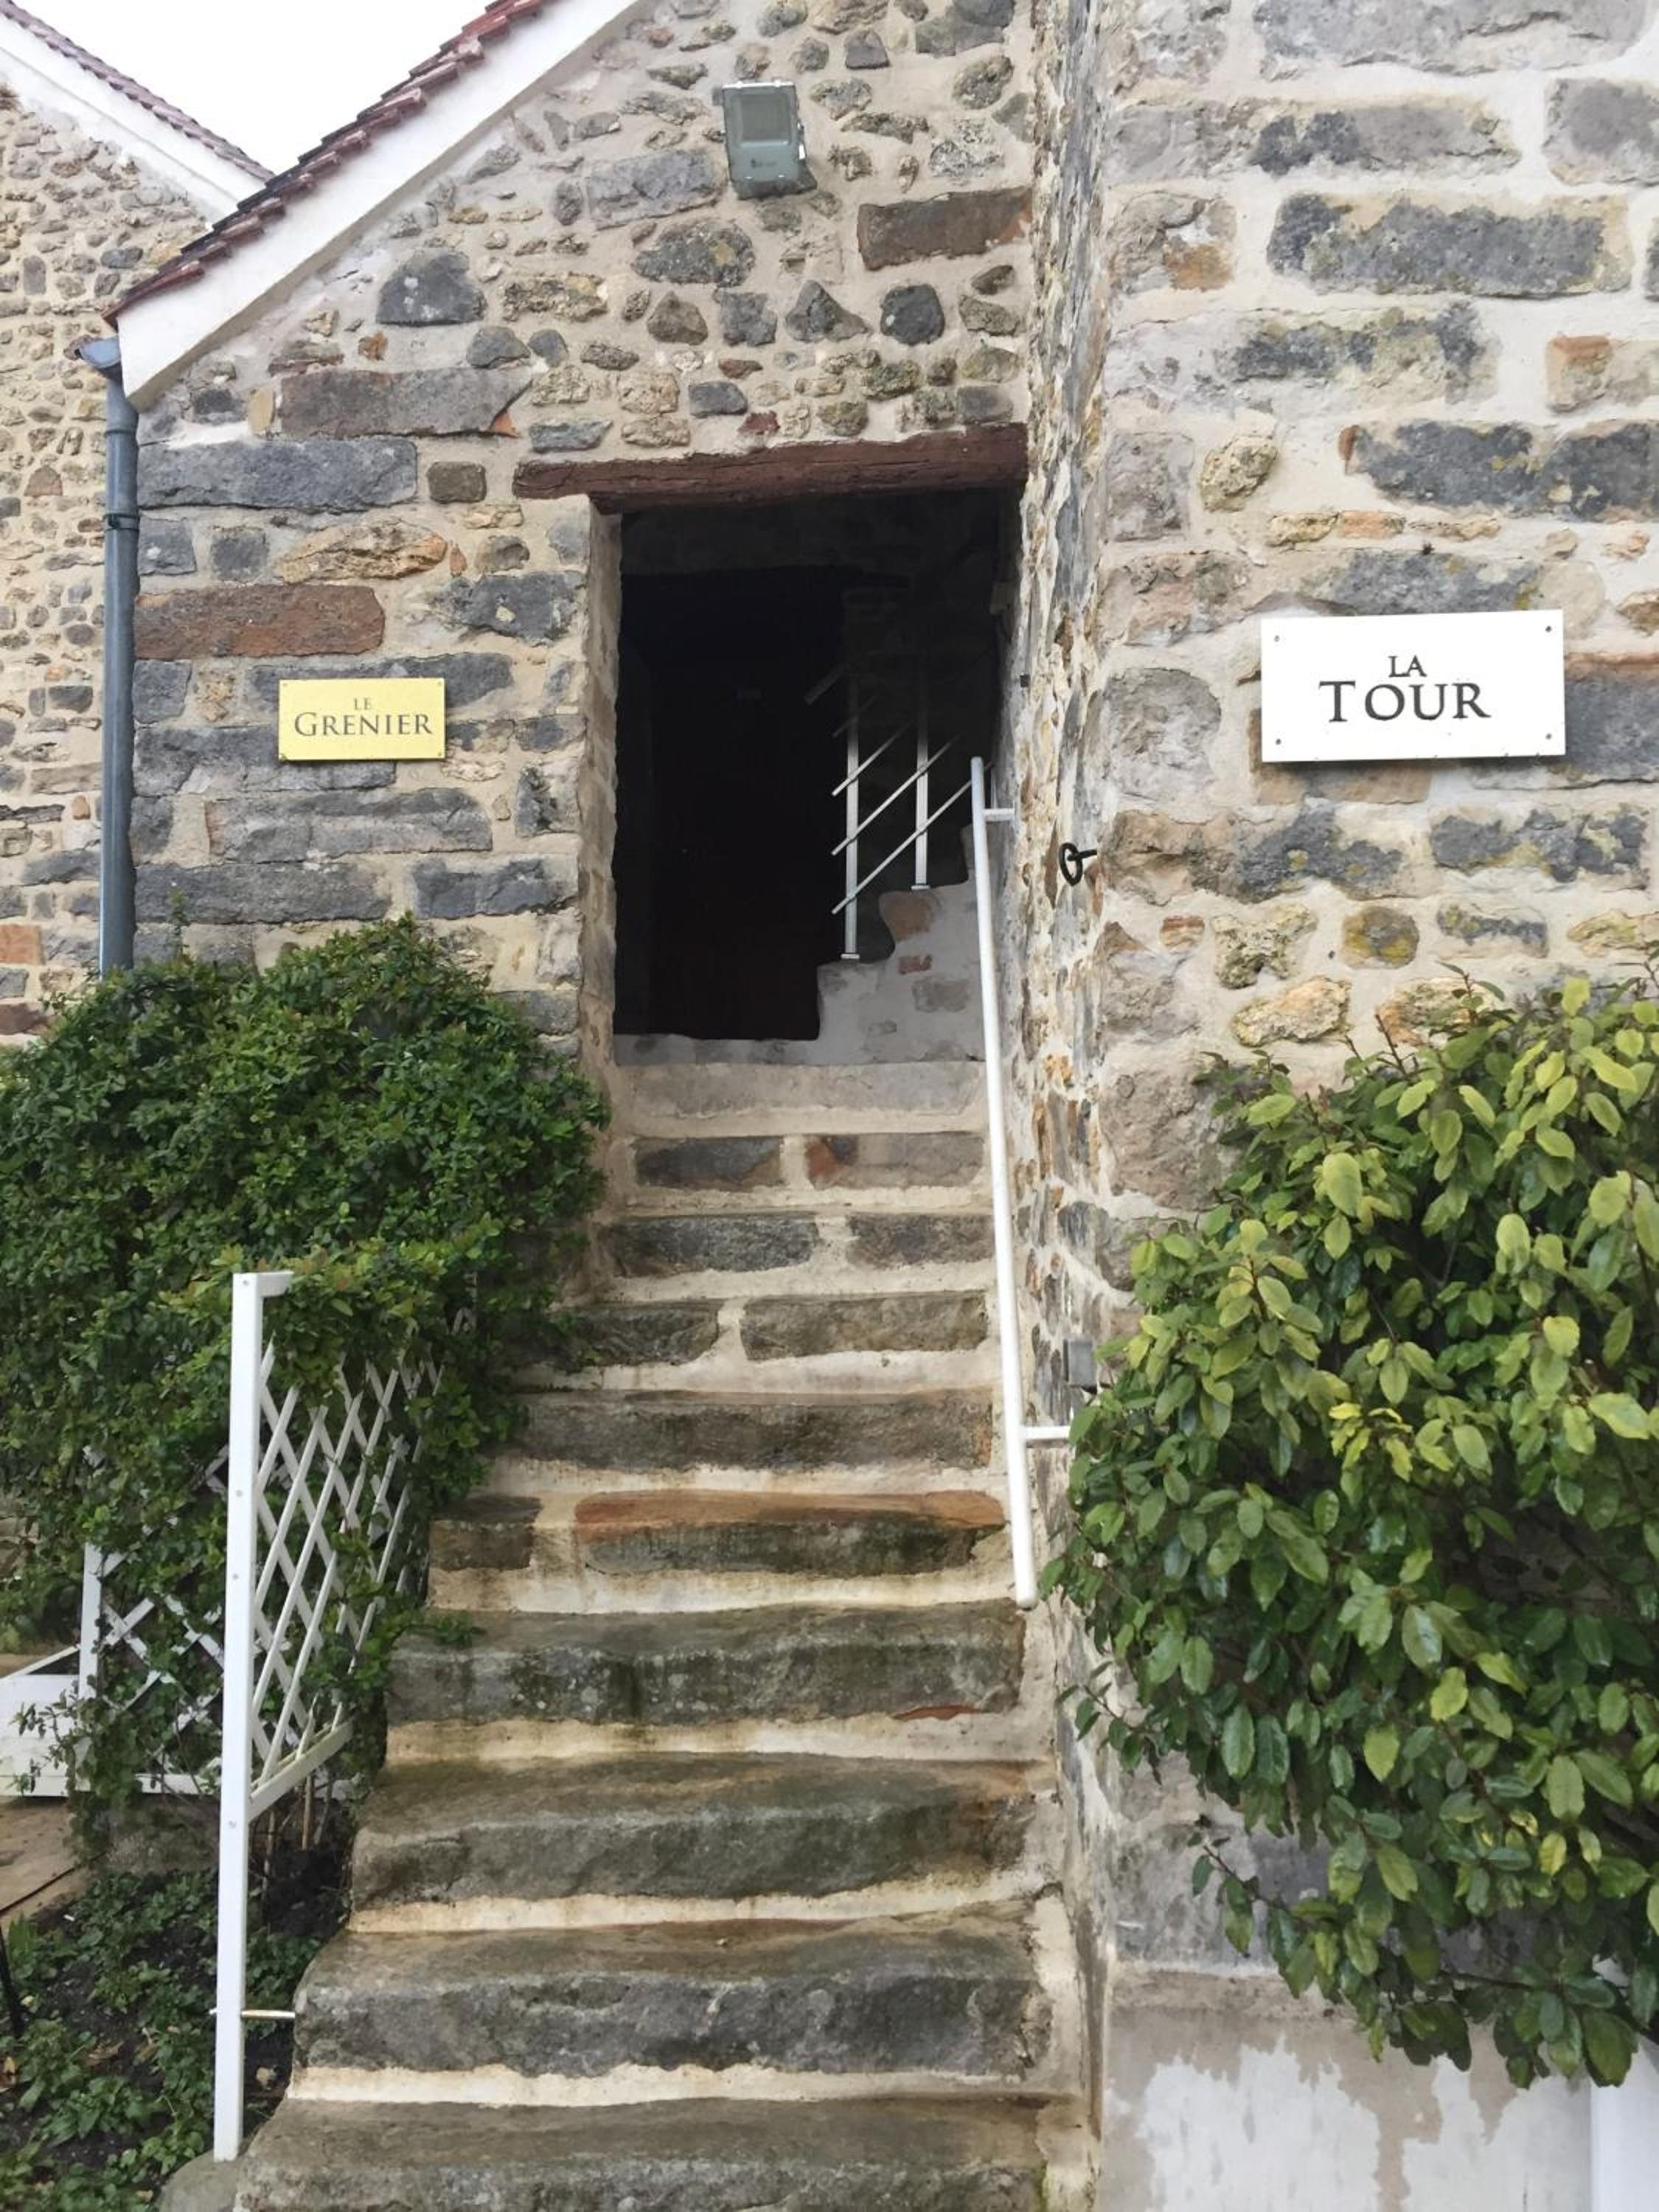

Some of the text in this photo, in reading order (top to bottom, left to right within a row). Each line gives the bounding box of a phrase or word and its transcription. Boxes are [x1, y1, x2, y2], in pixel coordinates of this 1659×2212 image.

[1388, 655, 1427, 678] LA
[353, 697, 373, 711] LE
[1318, 681, 1492, 723] TOUR
[294, 712, 433, 737] GRENIER
